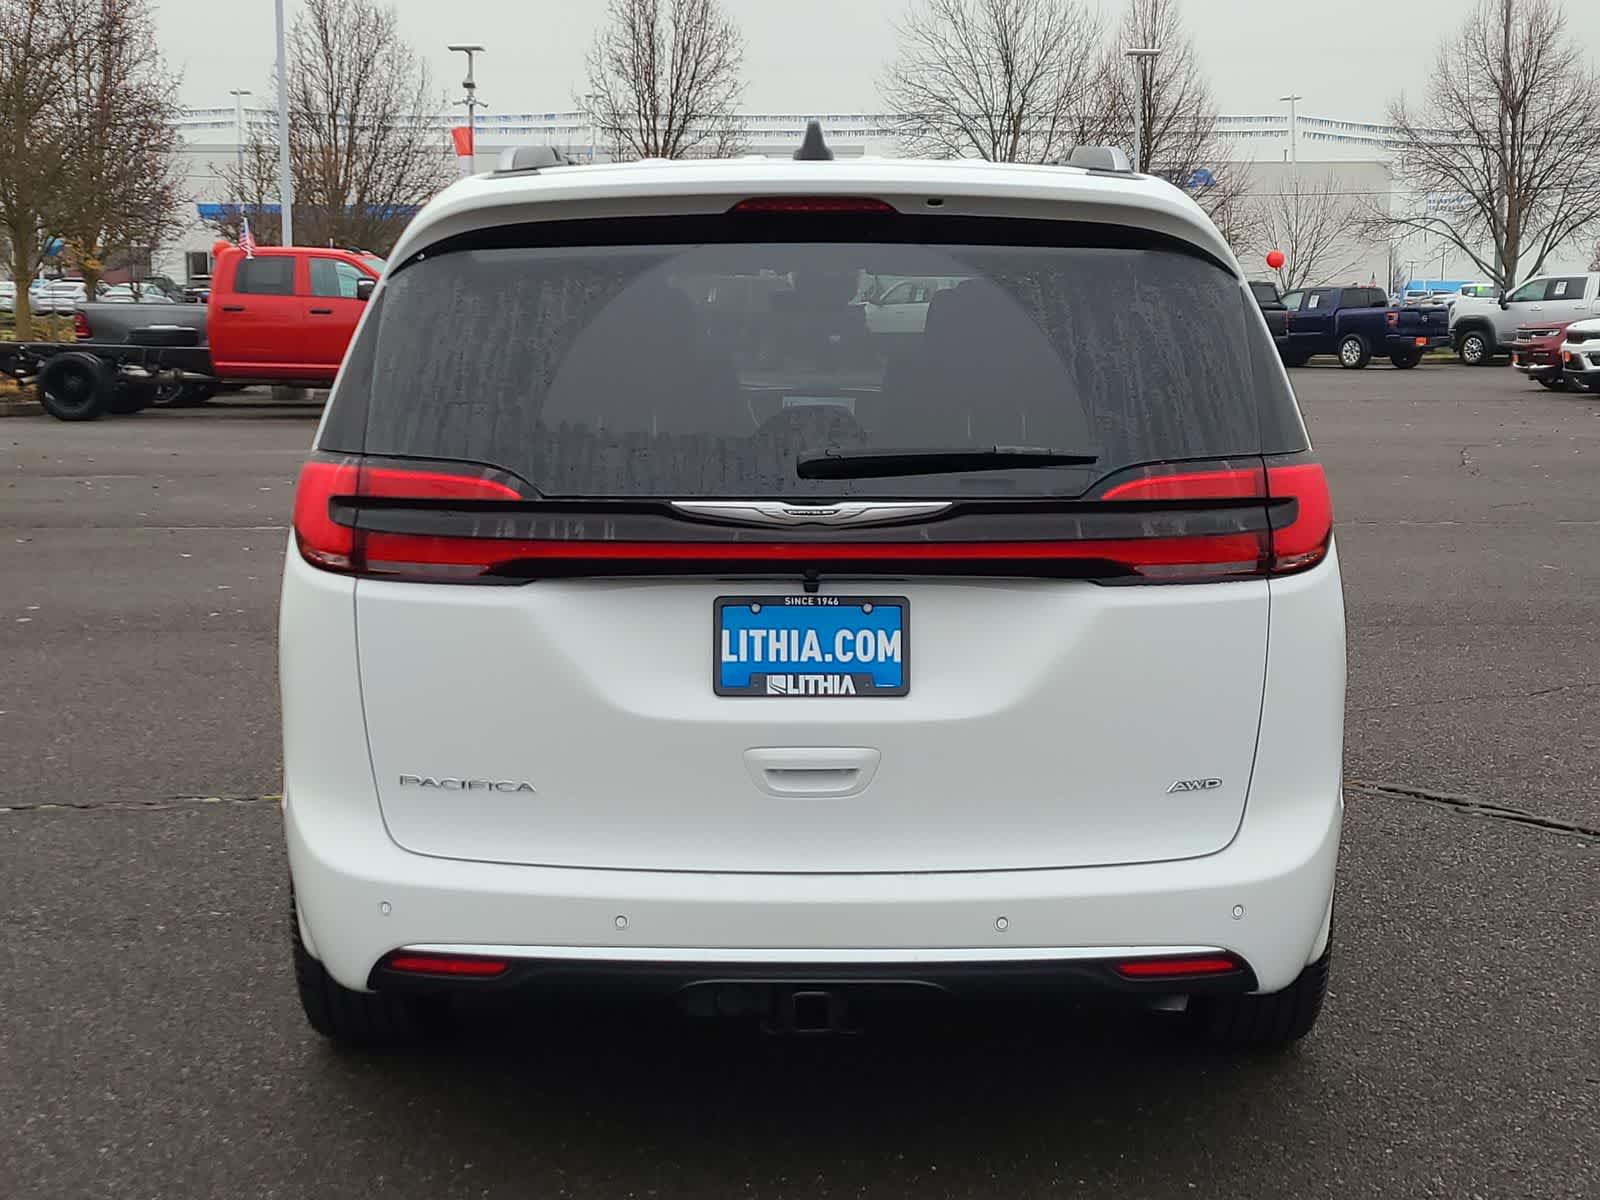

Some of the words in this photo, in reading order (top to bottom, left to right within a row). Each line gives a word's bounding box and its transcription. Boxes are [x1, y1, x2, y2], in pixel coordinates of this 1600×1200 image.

[784, 597, 814, 606] SINCE
[817, 597, 839, 606] 1946
[722, 629, 901, 663] LITHIA.COM
[787, 674, 856, 695] LITHIA
[399, 773, 537, 793] PACIFICA
[1166, 778, 1223, 793] AWD
